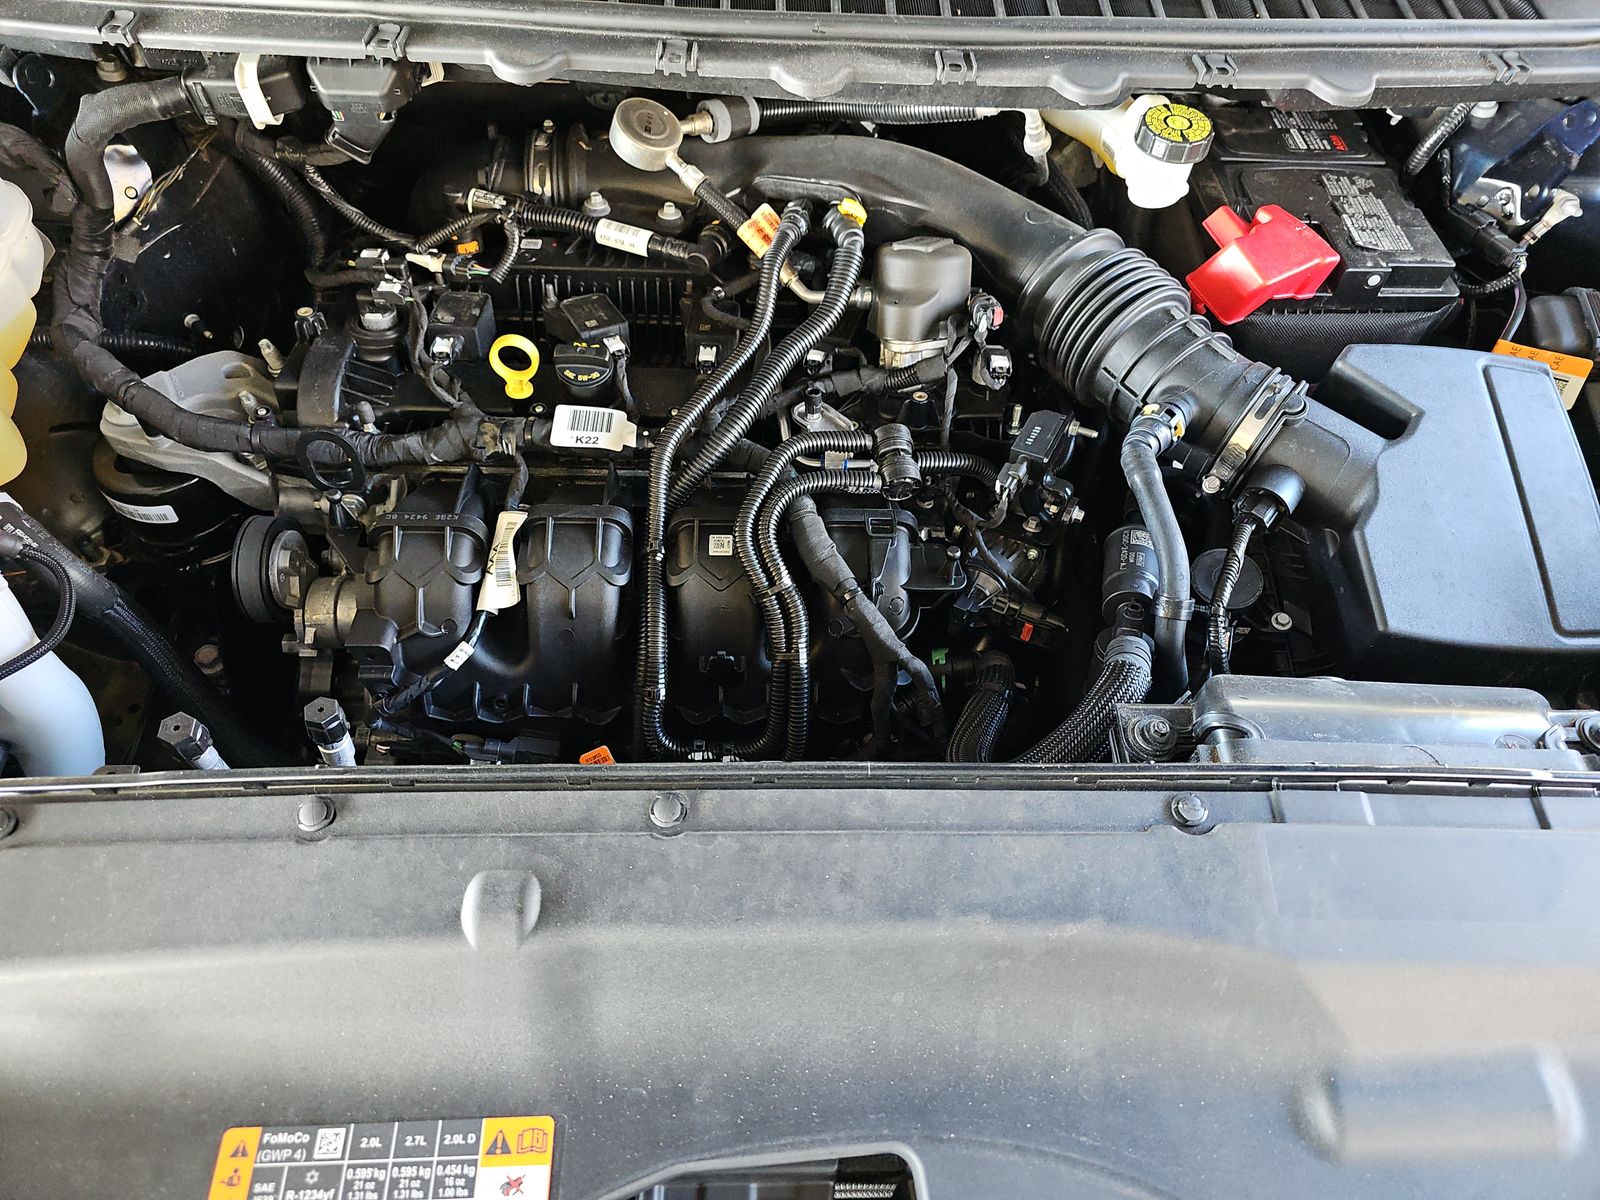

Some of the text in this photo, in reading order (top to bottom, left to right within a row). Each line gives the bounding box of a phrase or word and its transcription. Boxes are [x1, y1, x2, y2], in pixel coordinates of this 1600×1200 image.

[1510, 346, 1522, 358] AE
[1528, 350, 1540, 361] AE
[575, 435, 600, 445] K22
[263, 1131, 311, 1145] FoMoCo
[360, 1136, 383, 1148] 2.0L
[404, 1135, 428, 1146] 2.7L
[443, 1133, 477, 1145] 2.0L D
[256, 1148, 307, 1163] (GWP 4)
[373, 1167, 387, 1181] kg
[391, 1165, 432, 1180] 0.595 kg
[436, 1163, 476, 1178] 0.454 kg
[352, 1180, 376, 1190] 21 oz
[398, 1179, 421, 1188] 21 oz
[455, 1177, 466, 1186] oz
[253, 1182, 276, 1193] SAE
[455, 1187, 469, 1197] lbs
[285, 1187, 336, 1200] R-1234yf
[365, 1190, 379, 1200] lbs
[410, 1188, 424, 1199] lbs
